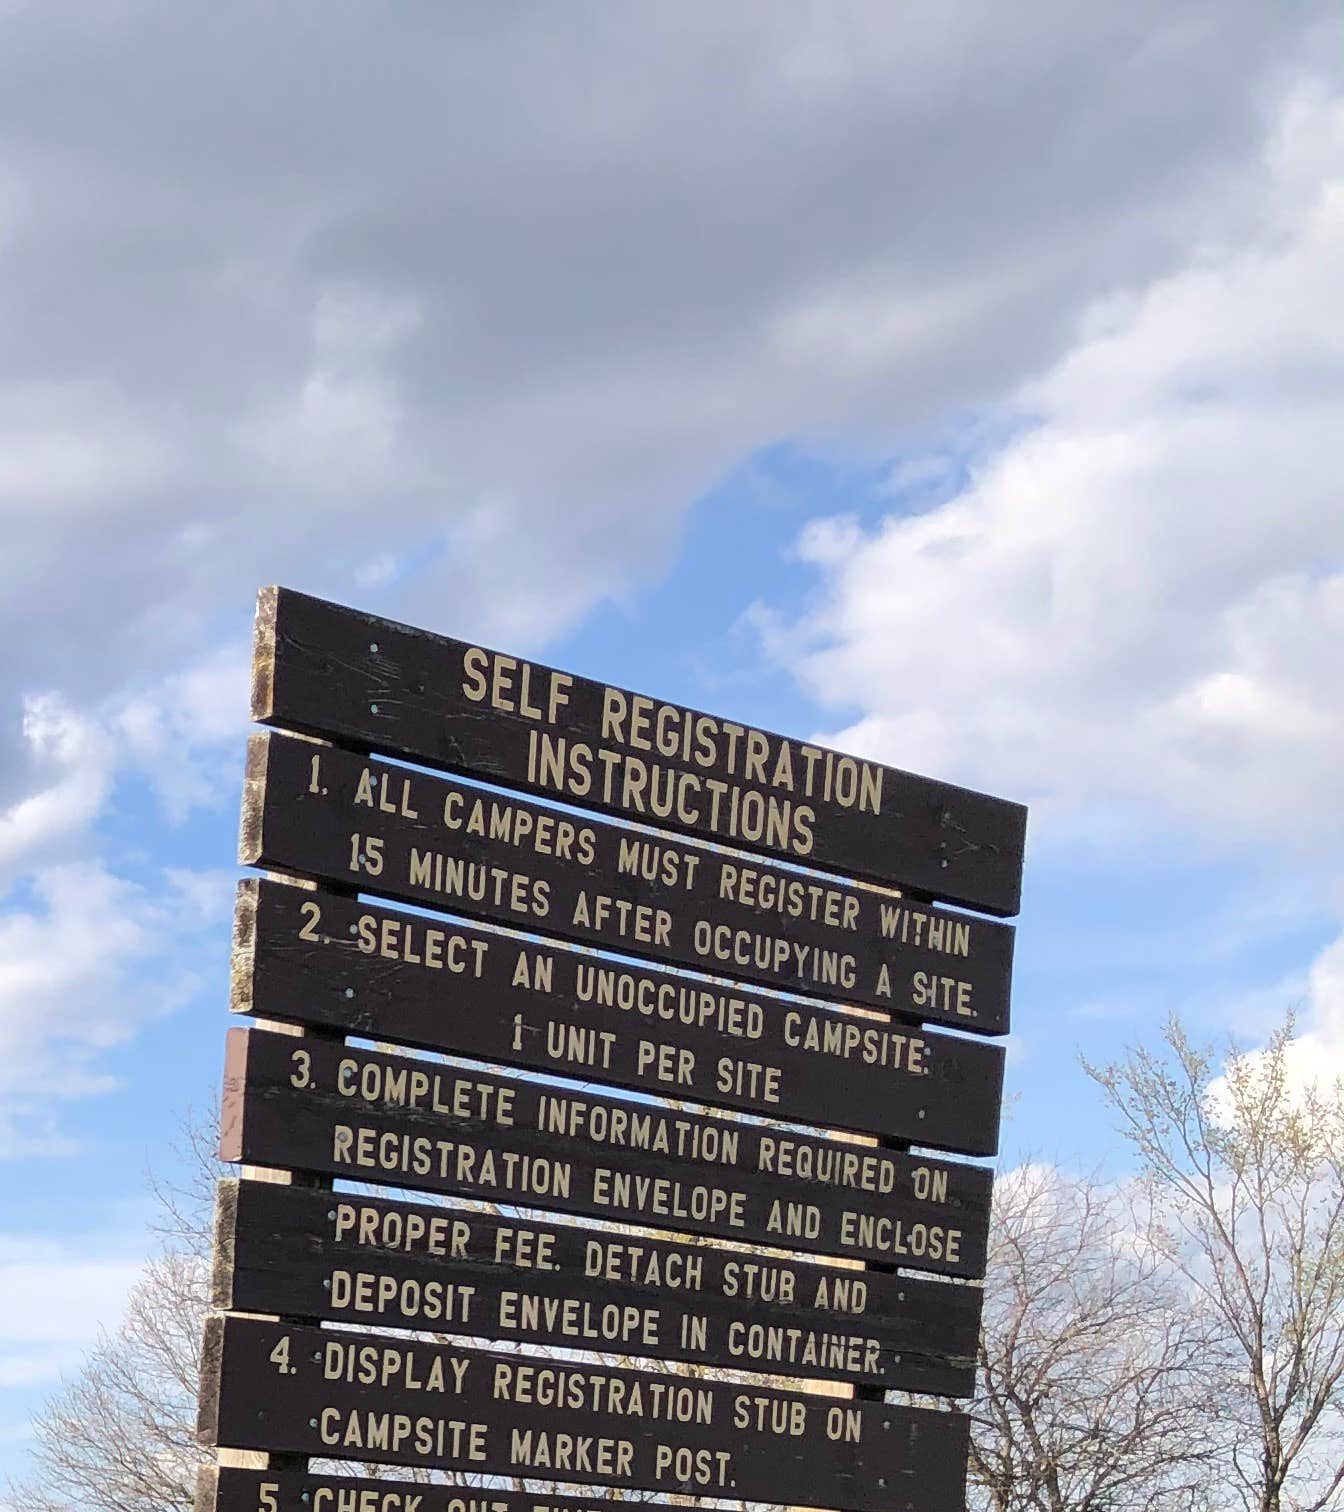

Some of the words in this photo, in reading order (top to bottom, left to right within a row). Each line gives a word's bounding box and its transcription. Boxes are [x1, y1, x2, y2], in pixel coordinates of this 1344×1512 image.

[462, 648, 574, 724] SELF
[602, 688, 883, 816] REGISTRATION
[528, 730, 815, 855] INSTRUCTIONS
[309, 755, 328, 795] 1.
[353, 768, 418, 819] ALL
[444, 792, 596, 865] CAMPERS
[618, 838, 699, 890] MUST
[720, 864, 859, 930] REGISTER
[881, 904, 970, 957] WITHIN
[299, 902, 330, 942] 2.
[357, 914, 489, 978] SELECT
[512, 952, 552, 992] AN
[577, 965, 763, 1038] UNOCCUPIED
[349, 833, 384, 875] 15
[410, 848, 550, 916] MINUTES
[573, 891, 672, 946] AFTER
[695, 921, 856, 988] OCCUPYING
[876, 964, 891, 998] A
[913, 972, 978, 1017] SITE.
[513, 1014, 526, 1051] 1
[548, 1021, 616, 1068] UNIT
[638, 1040, 695, 1085] PER
[717, 1058, 781, 1103] SITE
[290, 1050, 316, 1088] 3.
[338, 1059, 515, 1126] COMPLETE
[539, 1096, 738, 1164] INFORMATION
[759, 1137, 894, 1193] REQUIRED
[914, 1168, 948, 1204] ON
[334, 1125, 570, 1198] REGISTRATION
[594, 1168, 746, 1227] ENVELOPE
[767, 1200, 820, 1238] AND
[841, 1212, 961, 1262] ENCLOSE
[331, 1271, 475, 1322] DEPOSIT
[500, 1291, 659, 1344] ENVELOPE
[682, 1314, 707, 1351] IN
[729, 1322, 884, 1375] CONTAINER.
[336, 1204, 476, 1260] PROPER
[492, 1228, 560, 1271] FEE.
[585, 1241, 702, 1290] DETACH
[723, 1263, 795, 1304] STUB
[814, 1277, 868, 1315] AND
[270, 1336, 296, 1374] 4.
[324, 1342, 470, 1393] DISPLAY
[494, 1364, 712, 1424] REGISTRATION
[734, 1396, 806, 1435] STUB
[827, 1408, 861, 1443] ON
[321, 1408, 487, 1460] CAMPSITE
[511, 1429, 633, 1476] MARKER
[656, 1445, 735, 1487] POST.
